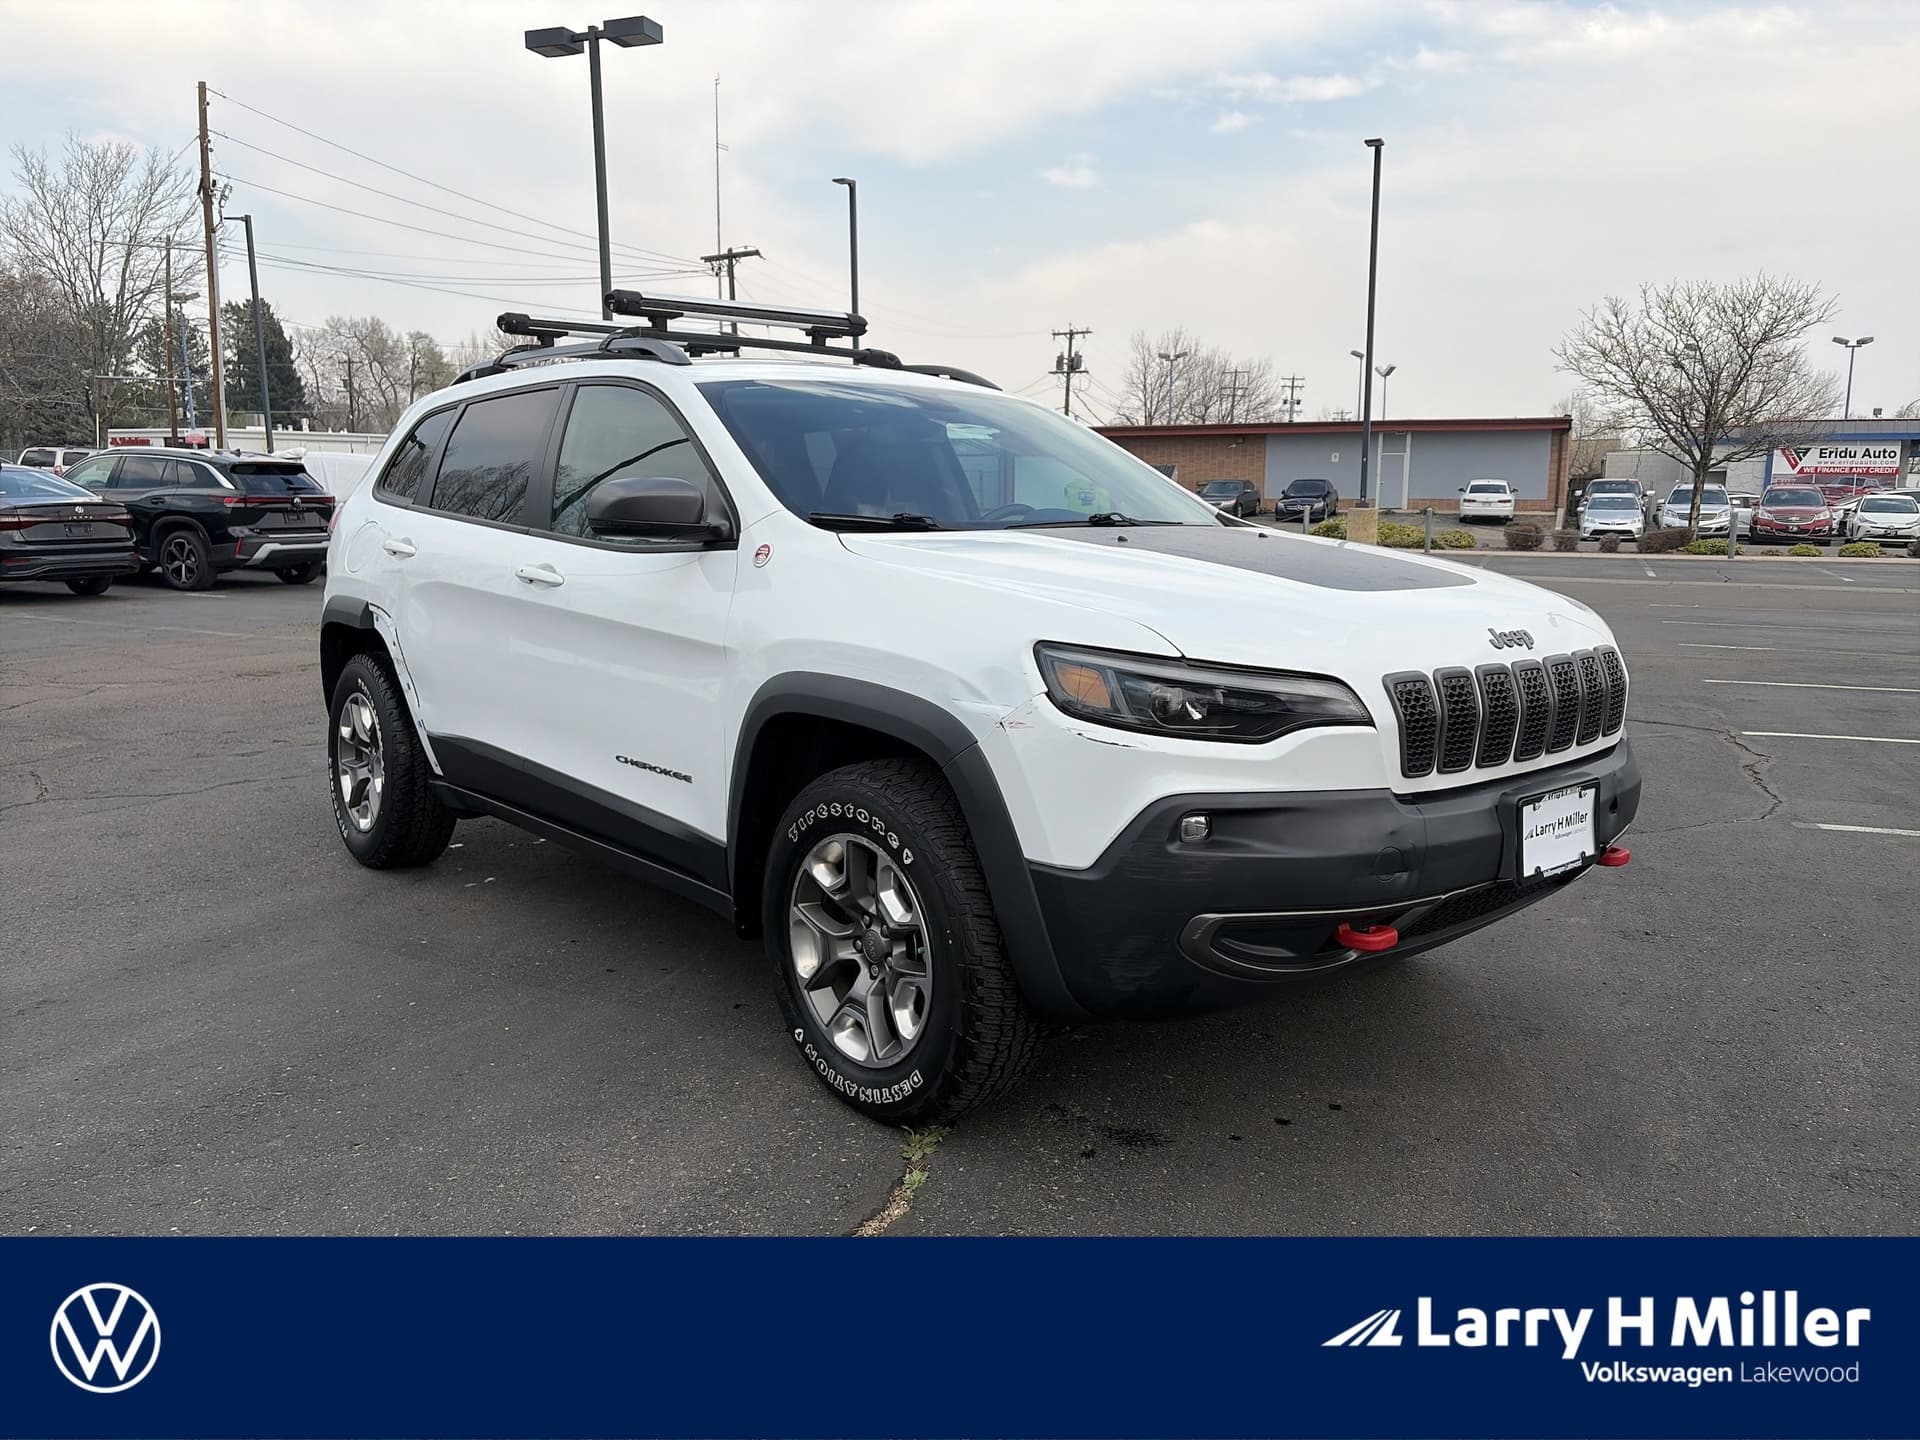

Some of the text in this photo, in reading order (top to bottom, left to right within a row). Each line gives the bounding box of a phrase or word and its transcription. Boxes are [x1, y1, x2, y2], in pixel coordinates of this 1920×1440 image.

[1818, 447, 1897, 459] Eridu Auto
[1487, 627, 1535, 651] Jeep
[615, 754, 693, 784] CHEROKEE
[1535, 821, 1557, 837] Larry
[1557, 816, 1564, 830] H
[1564, 810, 1588, 829] Miller
[805, 1043, 923, 1104] DESTINATION
